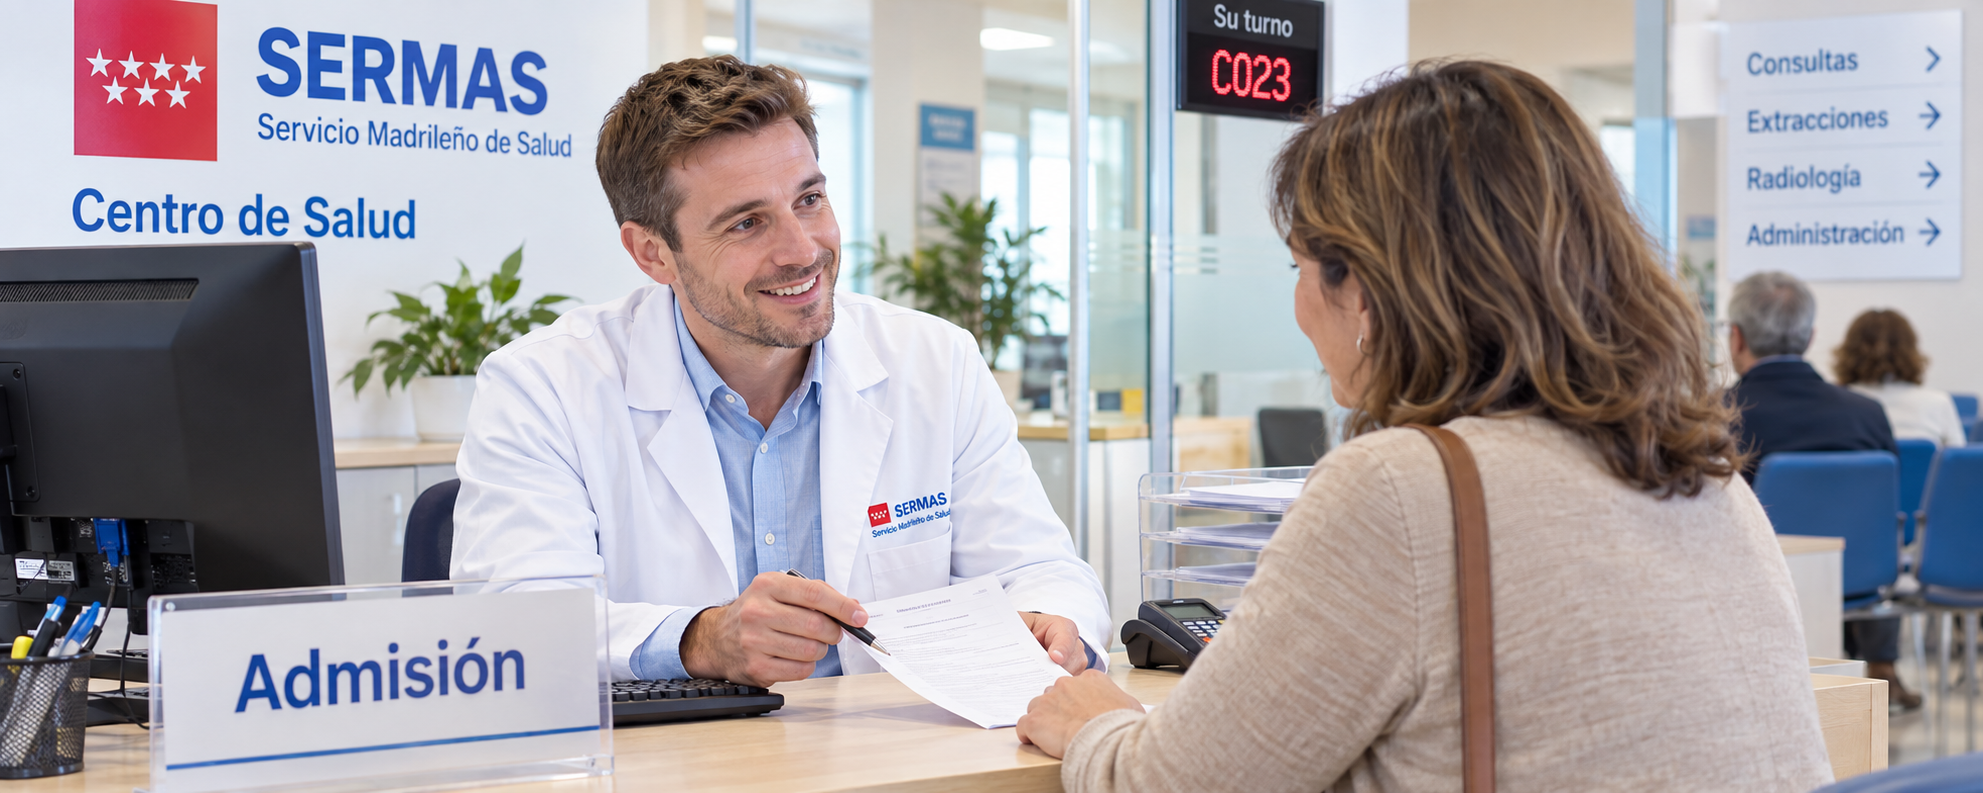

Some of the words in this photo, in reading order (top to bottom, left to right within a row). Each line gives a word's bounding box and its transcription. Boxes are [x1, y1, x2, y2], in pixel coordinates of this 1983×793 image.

[1213, 3, 1239, 29] Su
[1242, 9, 1294, 37] turno
[256, 26, 549, 117] SERMAS
[1211, 48, 1292, 103] C023
[1746, 47, 1860, 77] Consultas
[257, 112, 360, 146] Servicio
[367, 118, 479, 152] Madrileño
[486, 128, 512, 155] de
[516, 130, 572, 158] Salud
[1746, 105, 1890, 135] Extracciones
[1746, 162, 1863, 196] Radiología
[71, 187, 225, 236] Centro
[238, 192, 291, 238] de
[303, 195, 417, 241] Salud
[1746, 218, 1906, 247] Administración
[894, 491, 948, 518] SERMAS
[234, 636, 526, 714] Admisión
